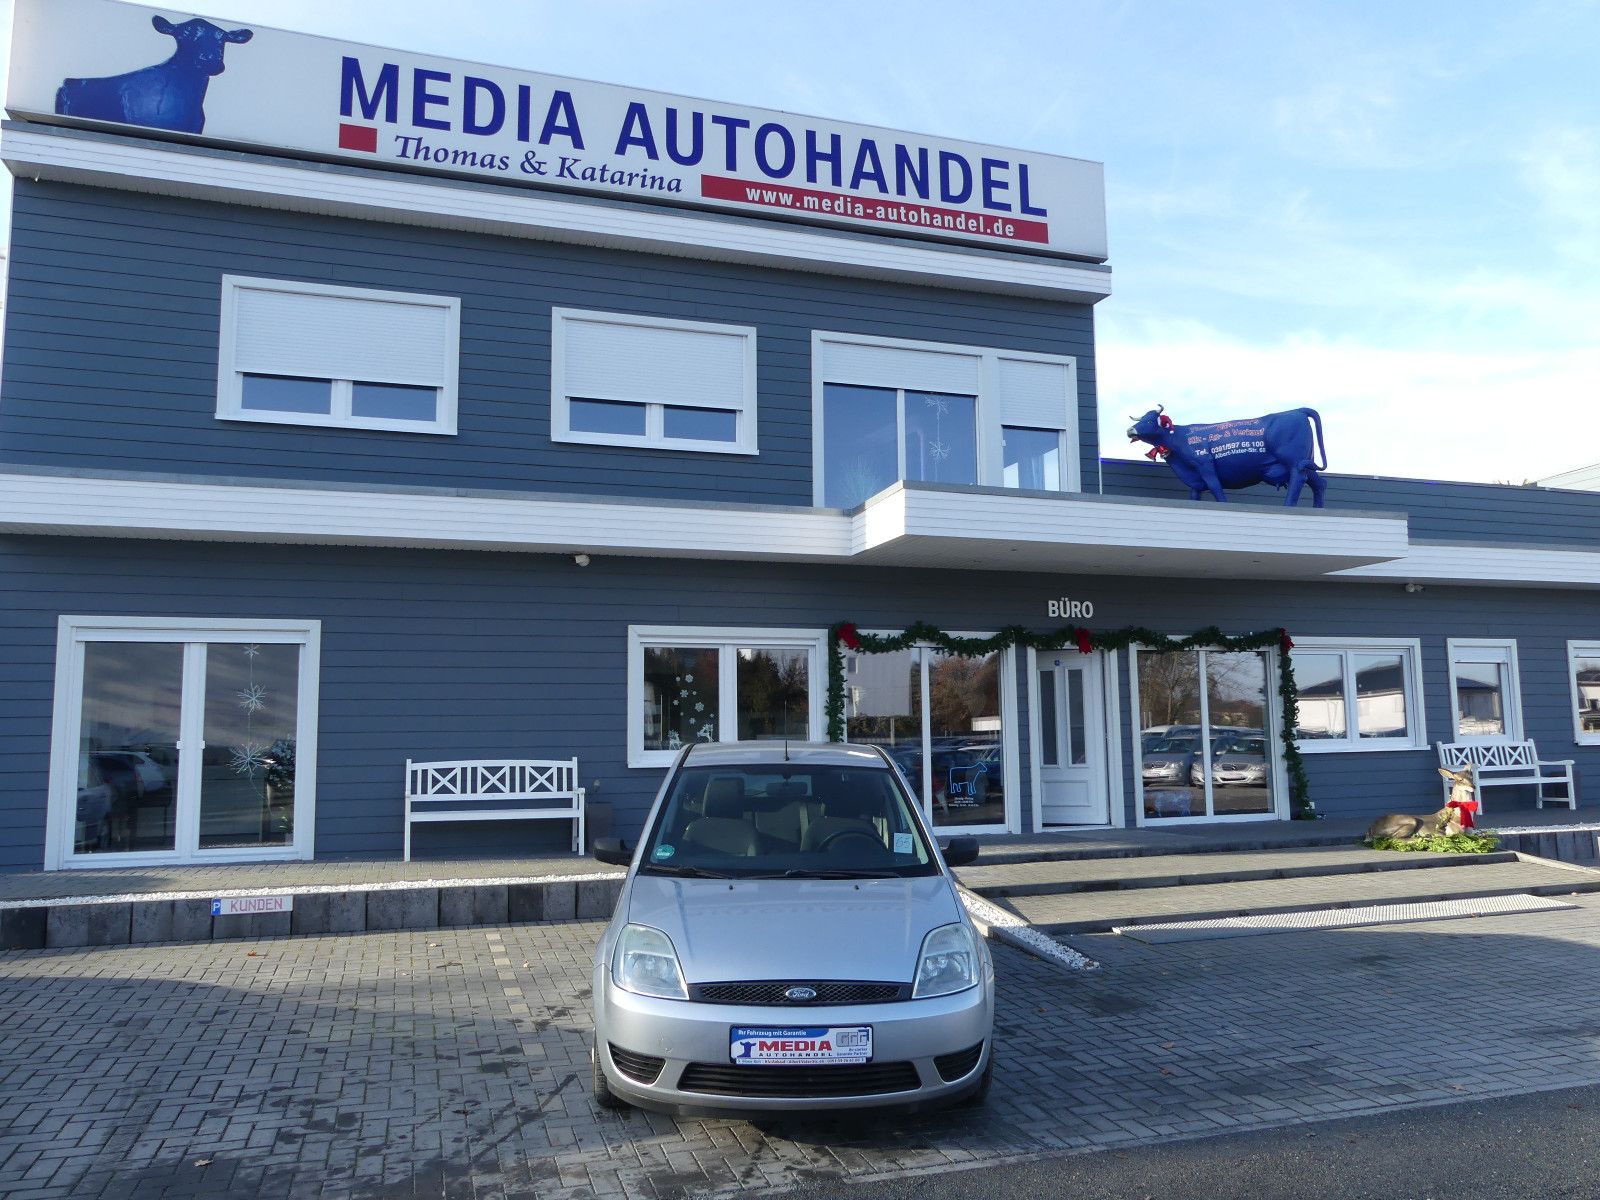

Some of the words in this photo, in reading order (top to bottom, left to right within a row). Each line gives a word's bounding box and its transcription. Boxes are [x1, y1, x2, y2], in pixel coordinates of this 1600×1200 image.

[340, 56, 585, 151] MEDIA
[614, 101, 1048, 217] AUTOHANDEL
[394, 134, 510, 171] Thomas
[519, 150, 548, 175] &
[556, 156, 683, 194] Katarina
[745, 184, 1015, 237] www.media-autohandel.de
[1195, 448, 1208, 456] Tel.
[1252, 440, 1265, 448] 100
[1048, 597, 1094, 618] BÜRO
[213, 902, 220, 912] P
[230, 897, 283, 912] KUNDEN
[758, 1040, 833, 1052] MEDIA
